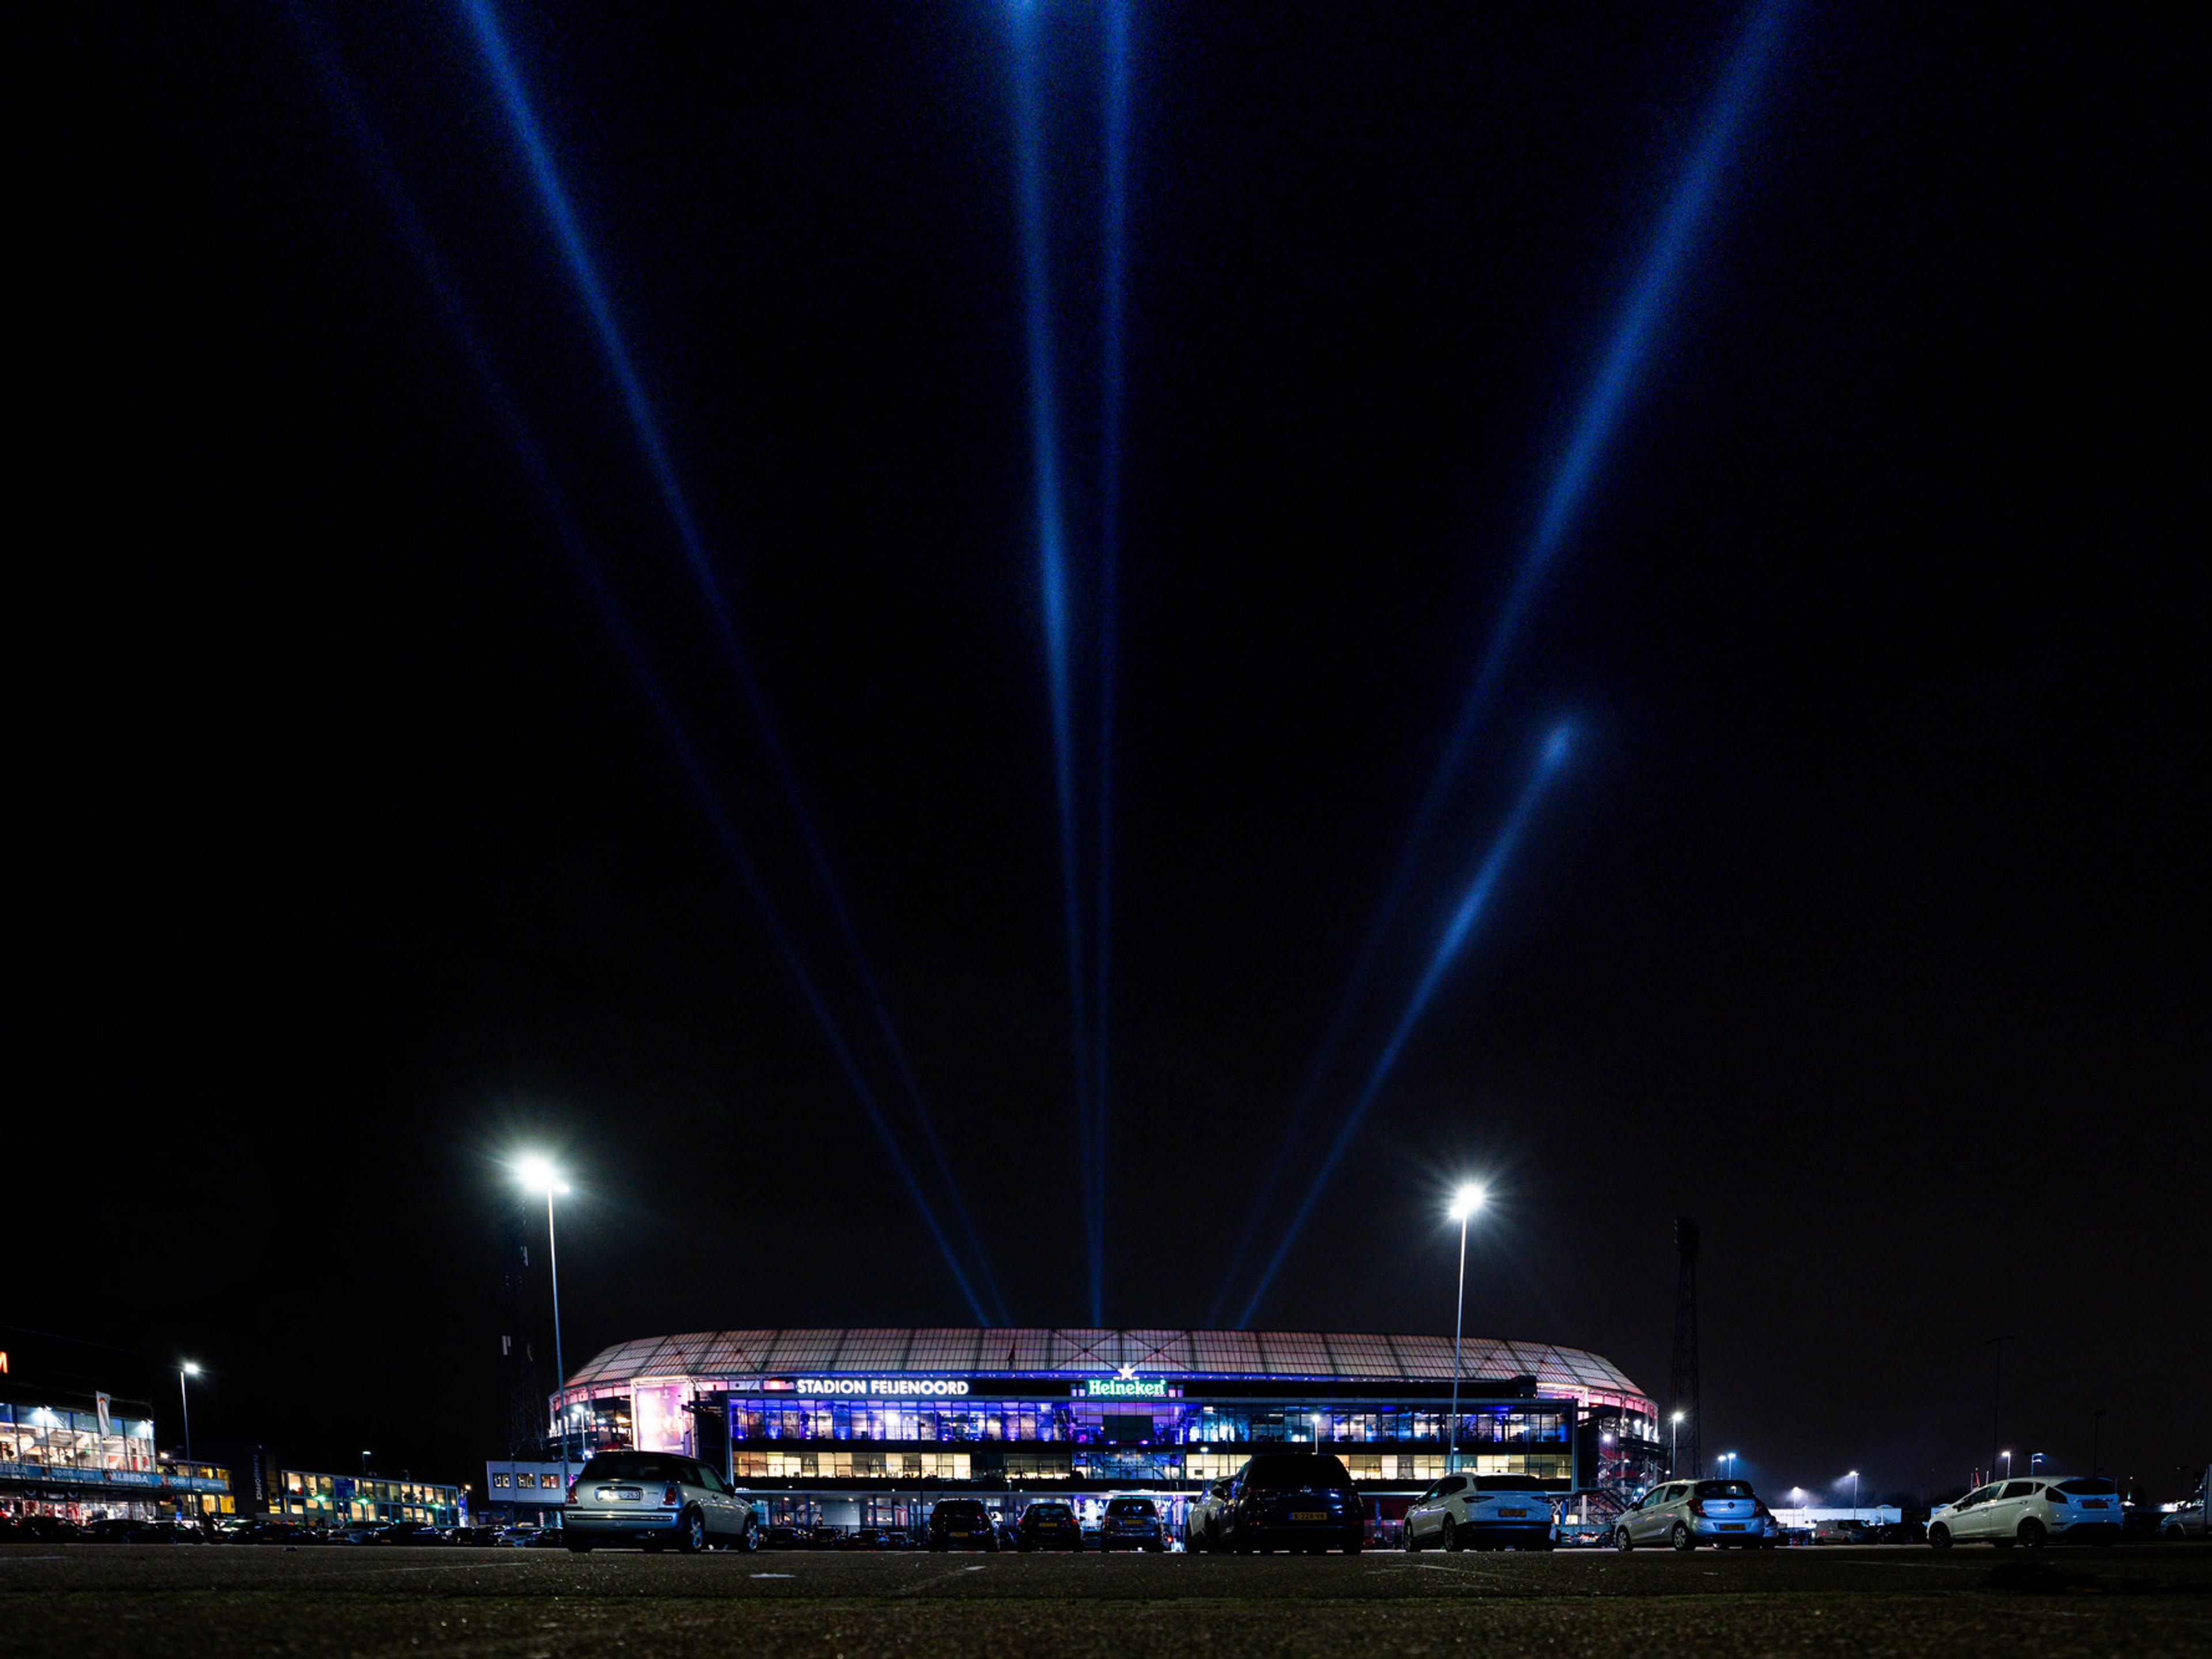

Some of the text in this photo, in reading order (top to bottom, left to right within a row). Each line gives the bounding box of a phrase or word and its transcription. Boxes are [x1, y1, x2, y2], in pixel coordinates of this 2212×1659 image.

[797, 1380, 969, 1395] STADION FEIJENOORD
[1088, 1380, 1165, 1395] Heineken
[110, 1473, 148, 1484] ALBEDA
